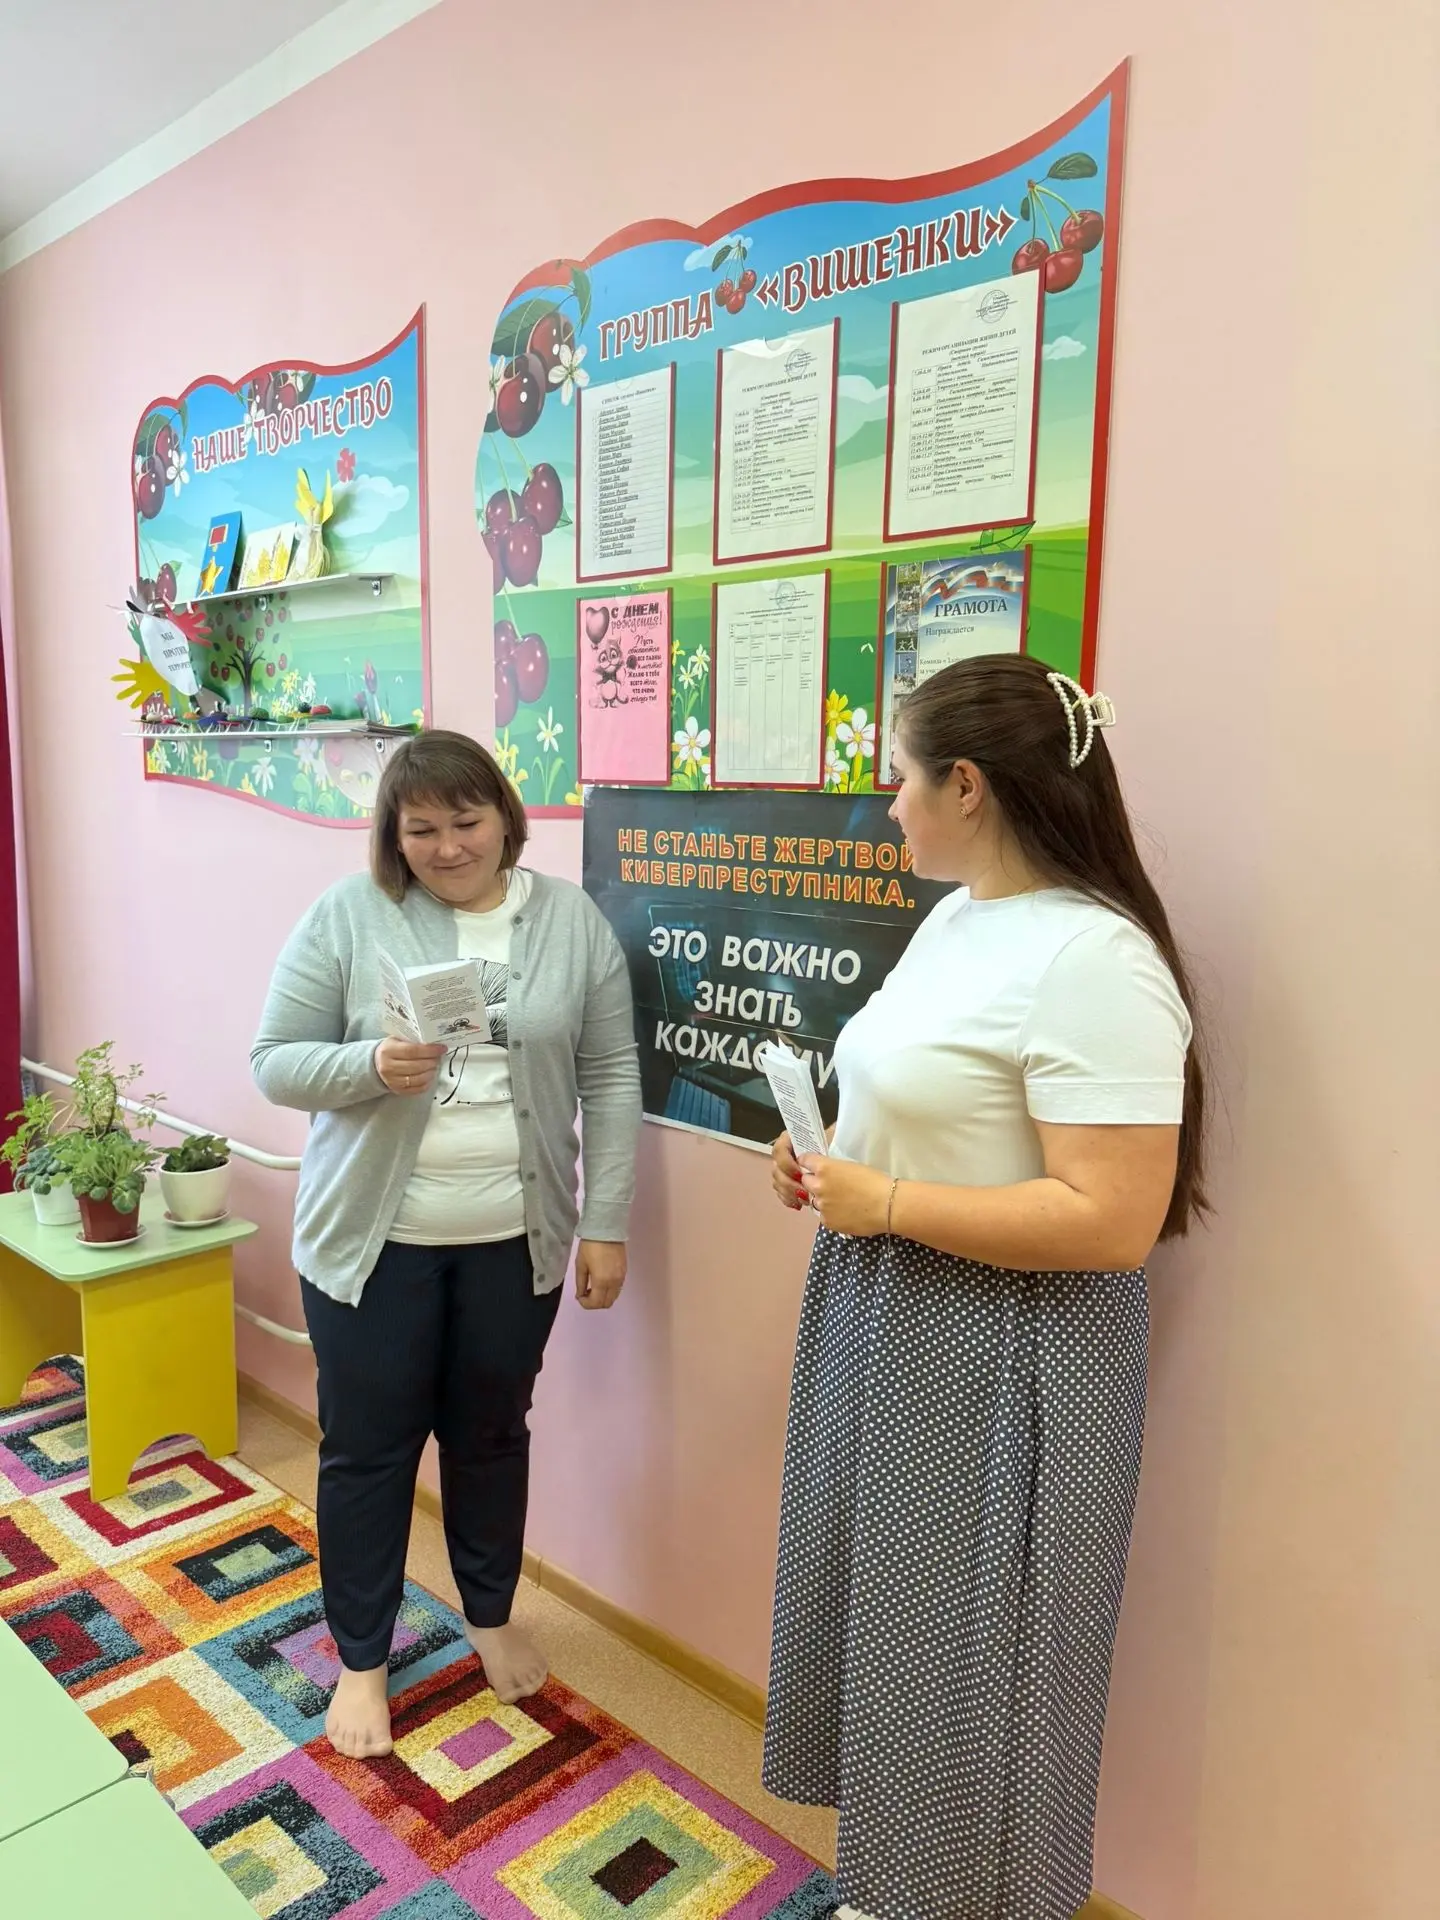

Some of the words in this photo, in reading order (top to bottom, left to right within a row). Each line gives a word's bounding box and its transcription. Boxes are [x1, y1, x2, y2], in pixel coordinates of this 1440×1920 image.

[598, 290, 714, 362] ГРУППА
[755, 205, 1018, 313] «ВИШЕНКИ»
[192, 425, 248, 473] НАШЕ
[254, 377, 393, 456] ТВОРЧЕСТВО
[611, 607, 619, 618] С
[623, 602, 659, 618] ДНЕМ
[935, 599, 1008, 617] ГРАМОТА
[925, 626, 974, 637] Награждается
[618, 829, 648, 853] НЕ
[653, 830, 767, 861] СТАНЬТЕ
[620, 859, 915, 908] КИБЕРПРЕСТУПНИКА.
